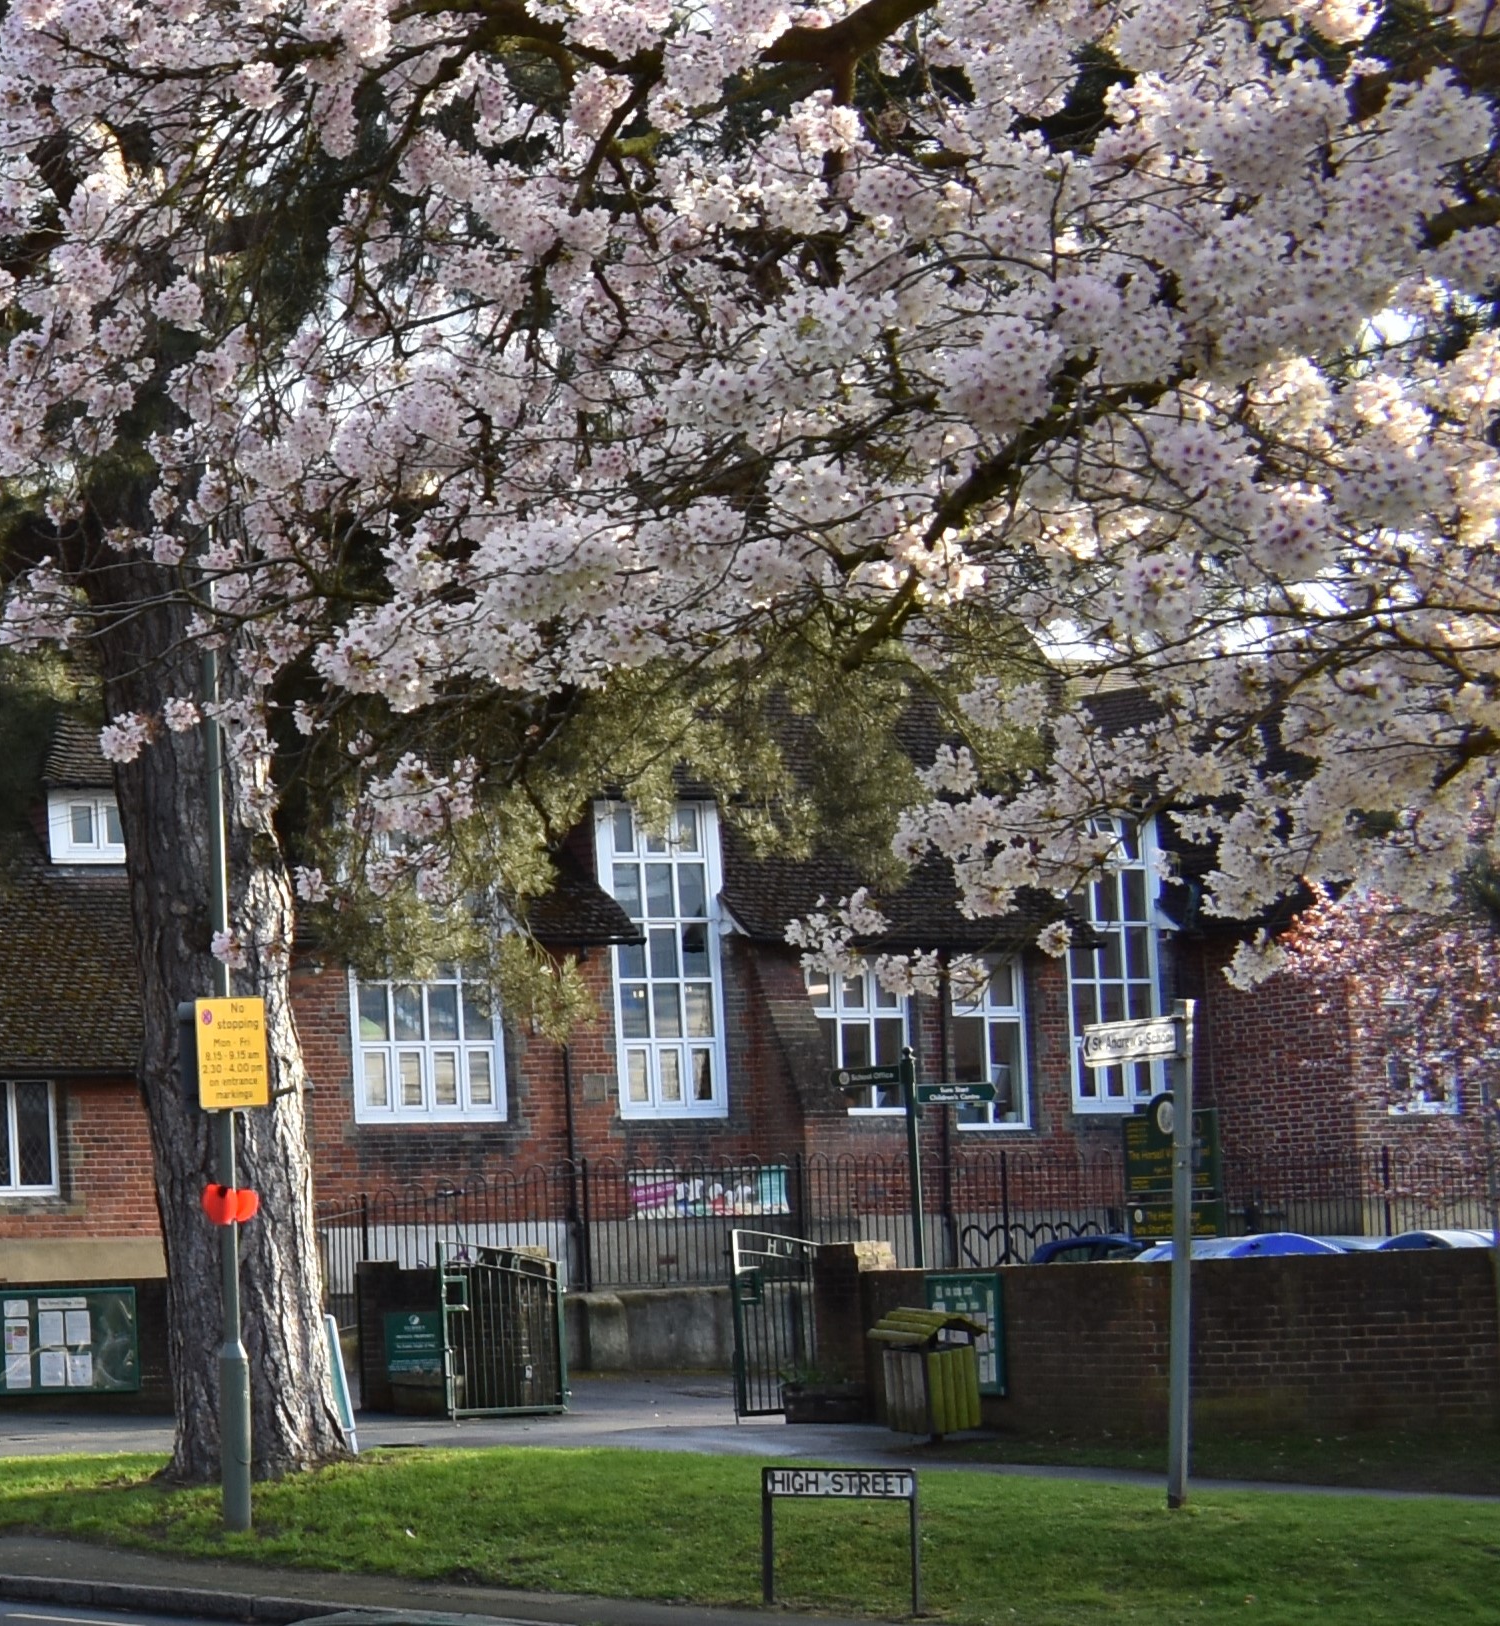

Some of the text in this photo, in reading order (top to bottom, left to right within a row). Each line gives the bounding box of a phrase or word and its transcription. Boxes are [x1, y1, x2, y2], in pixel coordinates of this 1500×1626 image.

[230, 1002, 245, 1014] No
[217, 1018, 260, 1031] stopping
[213, 1038, 231, 1048] Mon
[239, 1037, 251, 1047] Fri
[228, 1050, 245, 1060] 9.15
[202, 1064, 222, 1074] 2.30
[229, 1063, 249, 1073] 4.00
[222, 1077, 258, 1086] entrance
[215, 1090, 253, 1100] markings
[771, 1472, 909, 1494] HIGH STREET
